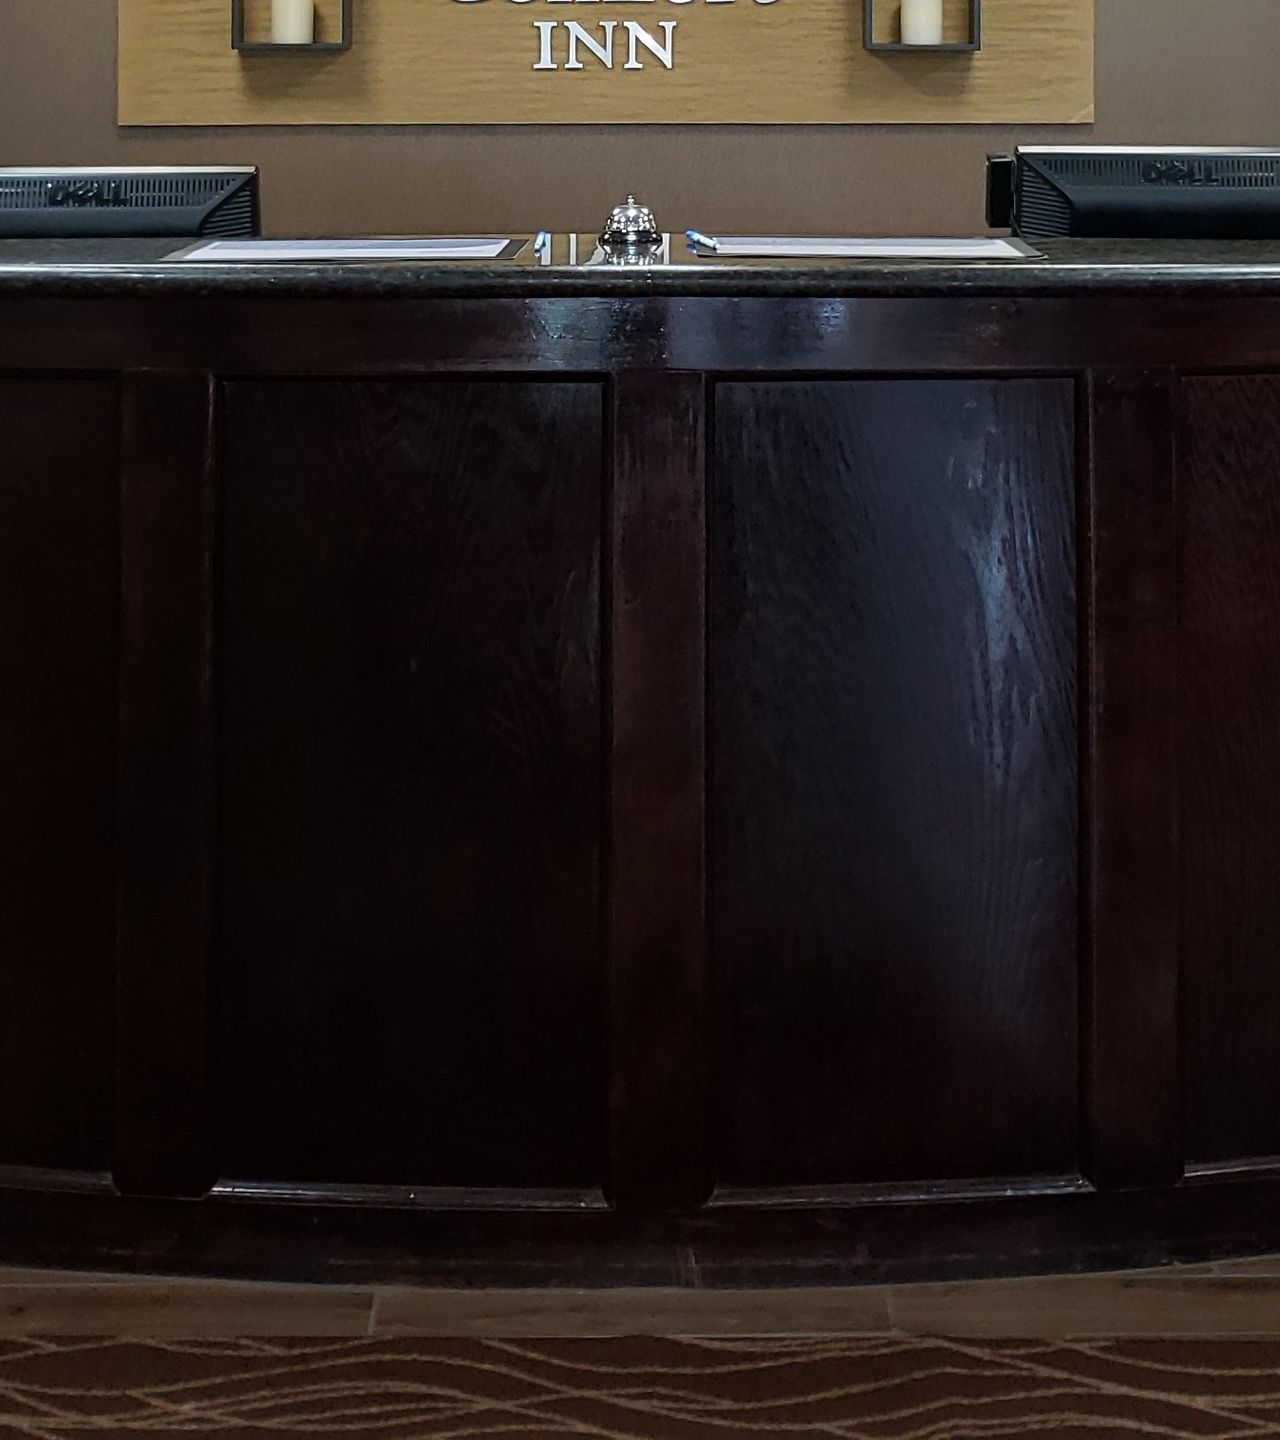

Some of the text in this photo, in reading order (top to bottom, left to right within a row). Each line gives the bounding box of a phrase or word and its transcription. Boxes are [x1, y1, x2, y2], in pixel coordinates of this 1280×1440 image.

[533, 20, 677, 70] INN
[1140, 159, 1219, 186] DELL
[48, 180, 130, 207] DELL
